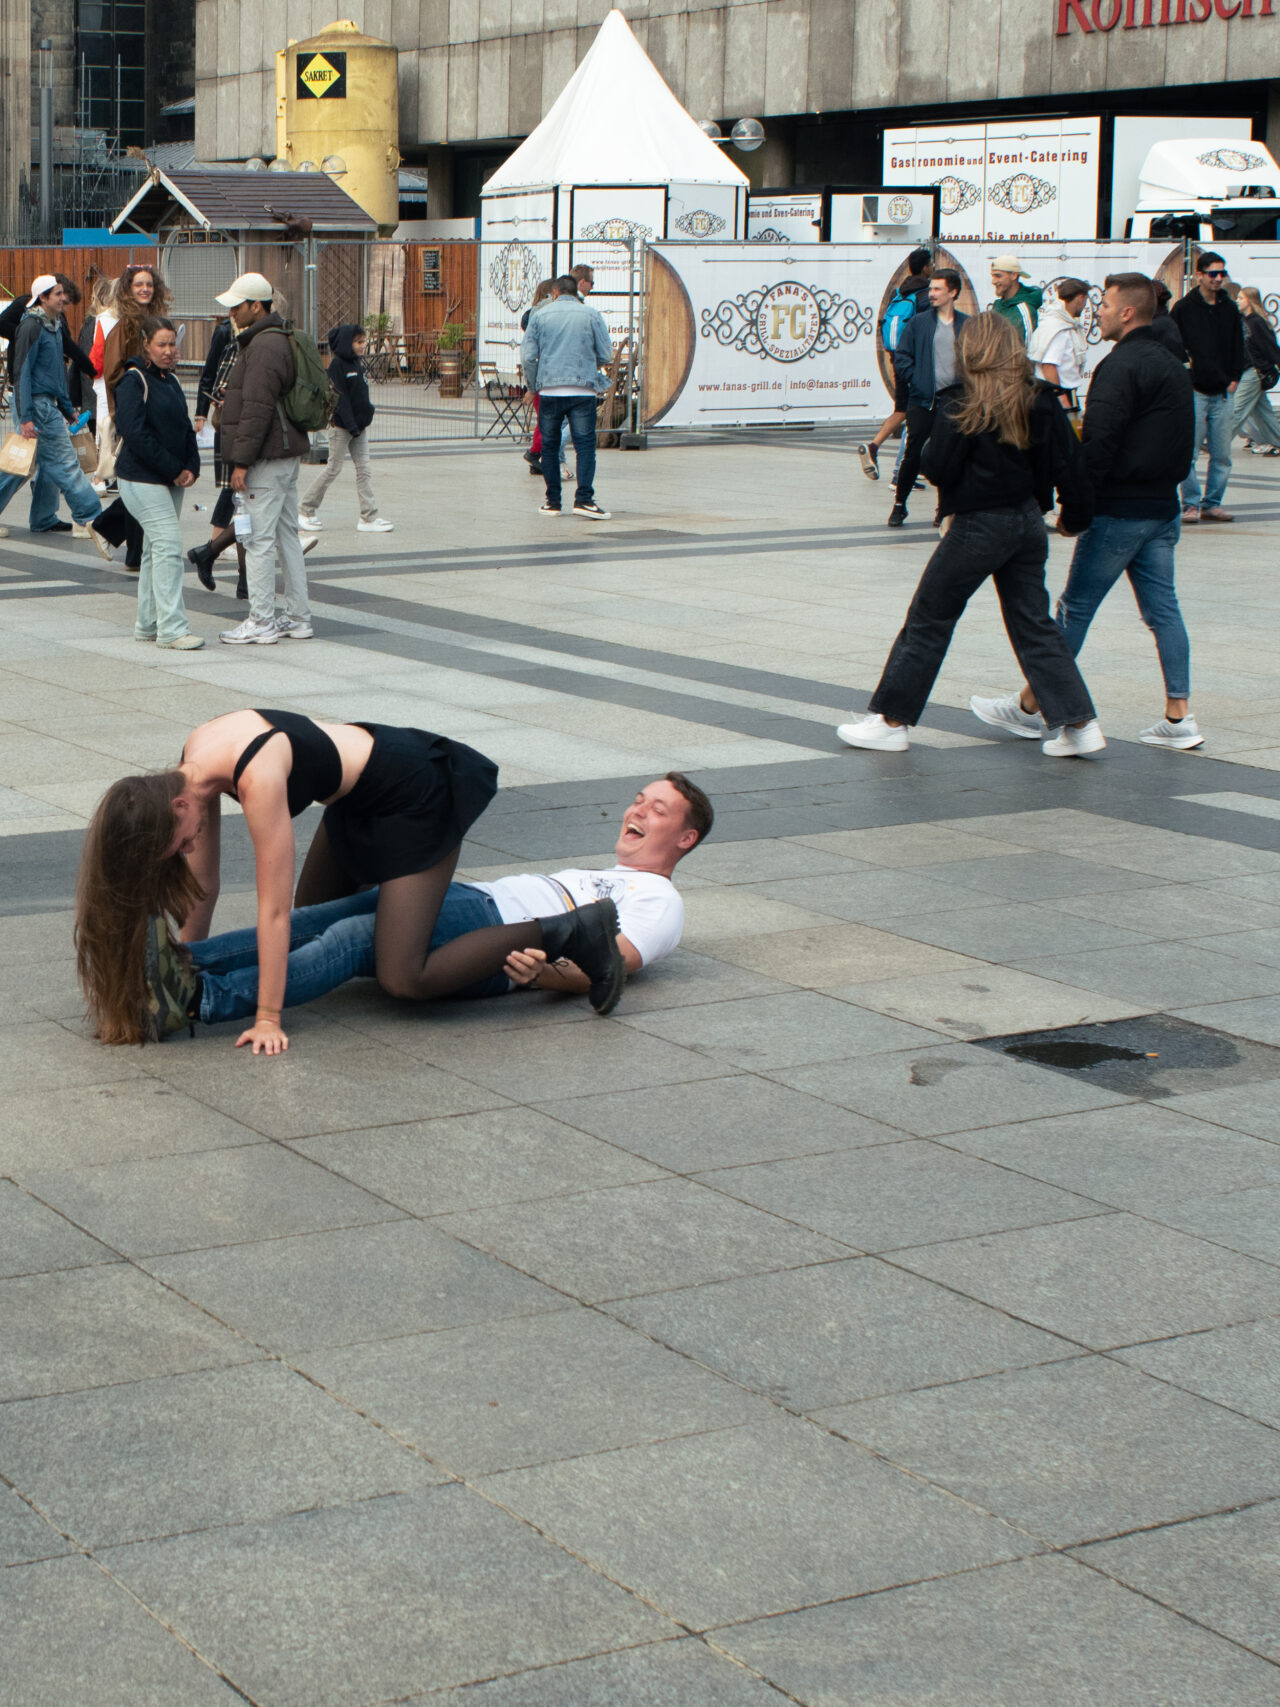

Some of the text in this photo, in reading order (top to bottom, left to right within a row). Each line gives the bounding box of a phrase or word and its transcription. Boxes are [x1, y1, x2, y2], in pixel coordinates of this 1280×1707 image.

[304, 70, 333, 82] SAKRET
[890, 149, 1089, 169] Gastronomie und Event-Catering
[761, 208, 773, 218] und
[986, 231, 1005, 241] Sie
[1009, 231, 1056, 241] mieten!
[769, 285, 809, 302] FANA'S
[770, 303, 806, 340] FG
[698, 380, 783, 393] www.fanas-grill.de
